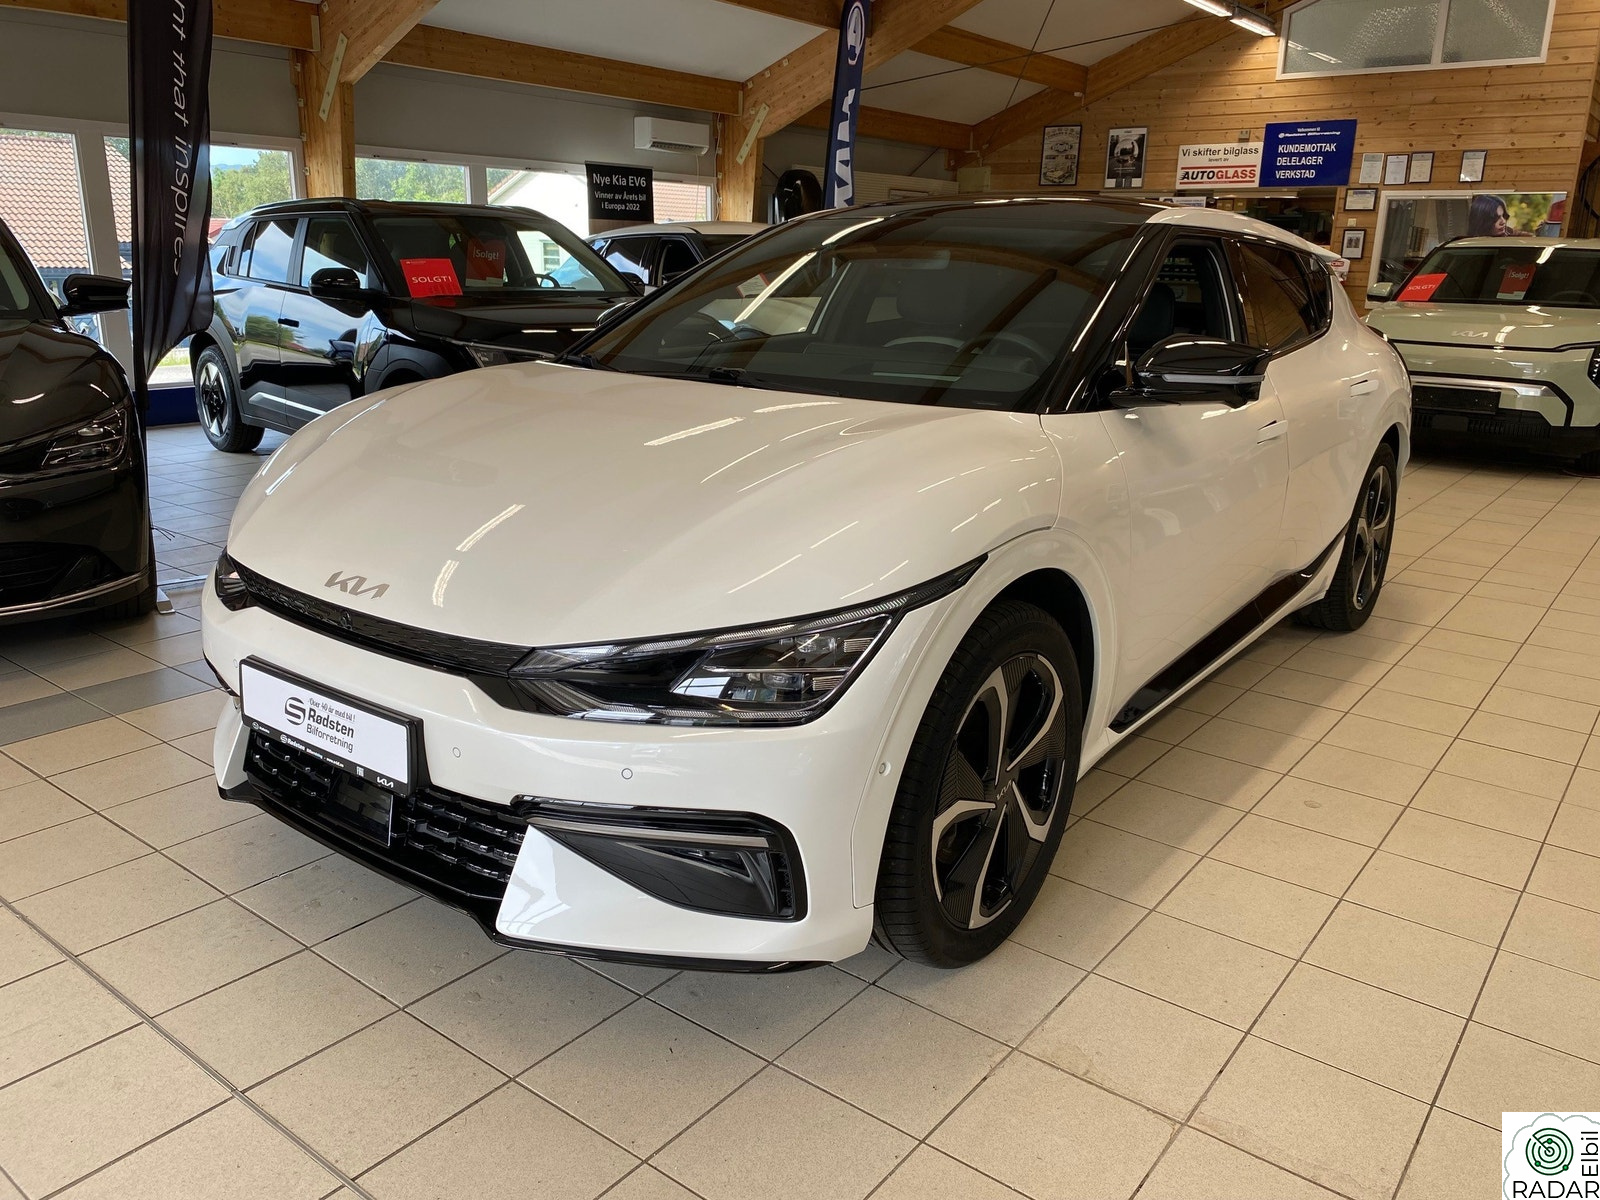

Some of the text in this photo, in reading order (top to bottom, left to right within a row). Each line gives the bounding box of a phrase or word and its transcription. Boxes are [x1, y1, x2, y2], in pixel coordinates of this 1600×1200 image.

[173, 50, 189, 127] that
[1182, 147, 1259, 157] Vi skifter bilglass
[1278, 143, 1337, 153] KUNDEMOTTAK
[1276, 156, 1323, 166] DELELAGER
[1180, 169, 1256, 181] AUTOGLASS
[1275, 170, 1316, 179] VERKSTAD
[593, 173, 647, 188] Nye Kia EV6
[594, 191, 614, 200] Vinner
[623, 191, 638, 201] Årets
[604, 201, 626, 211] Europa
[626, 203, 641, 211] 2022
[411, 275, 453, 284] SOLGT!
[308, 707, 354, 739] Rødsten
[306, 723, 354, 754] Bilforretning
